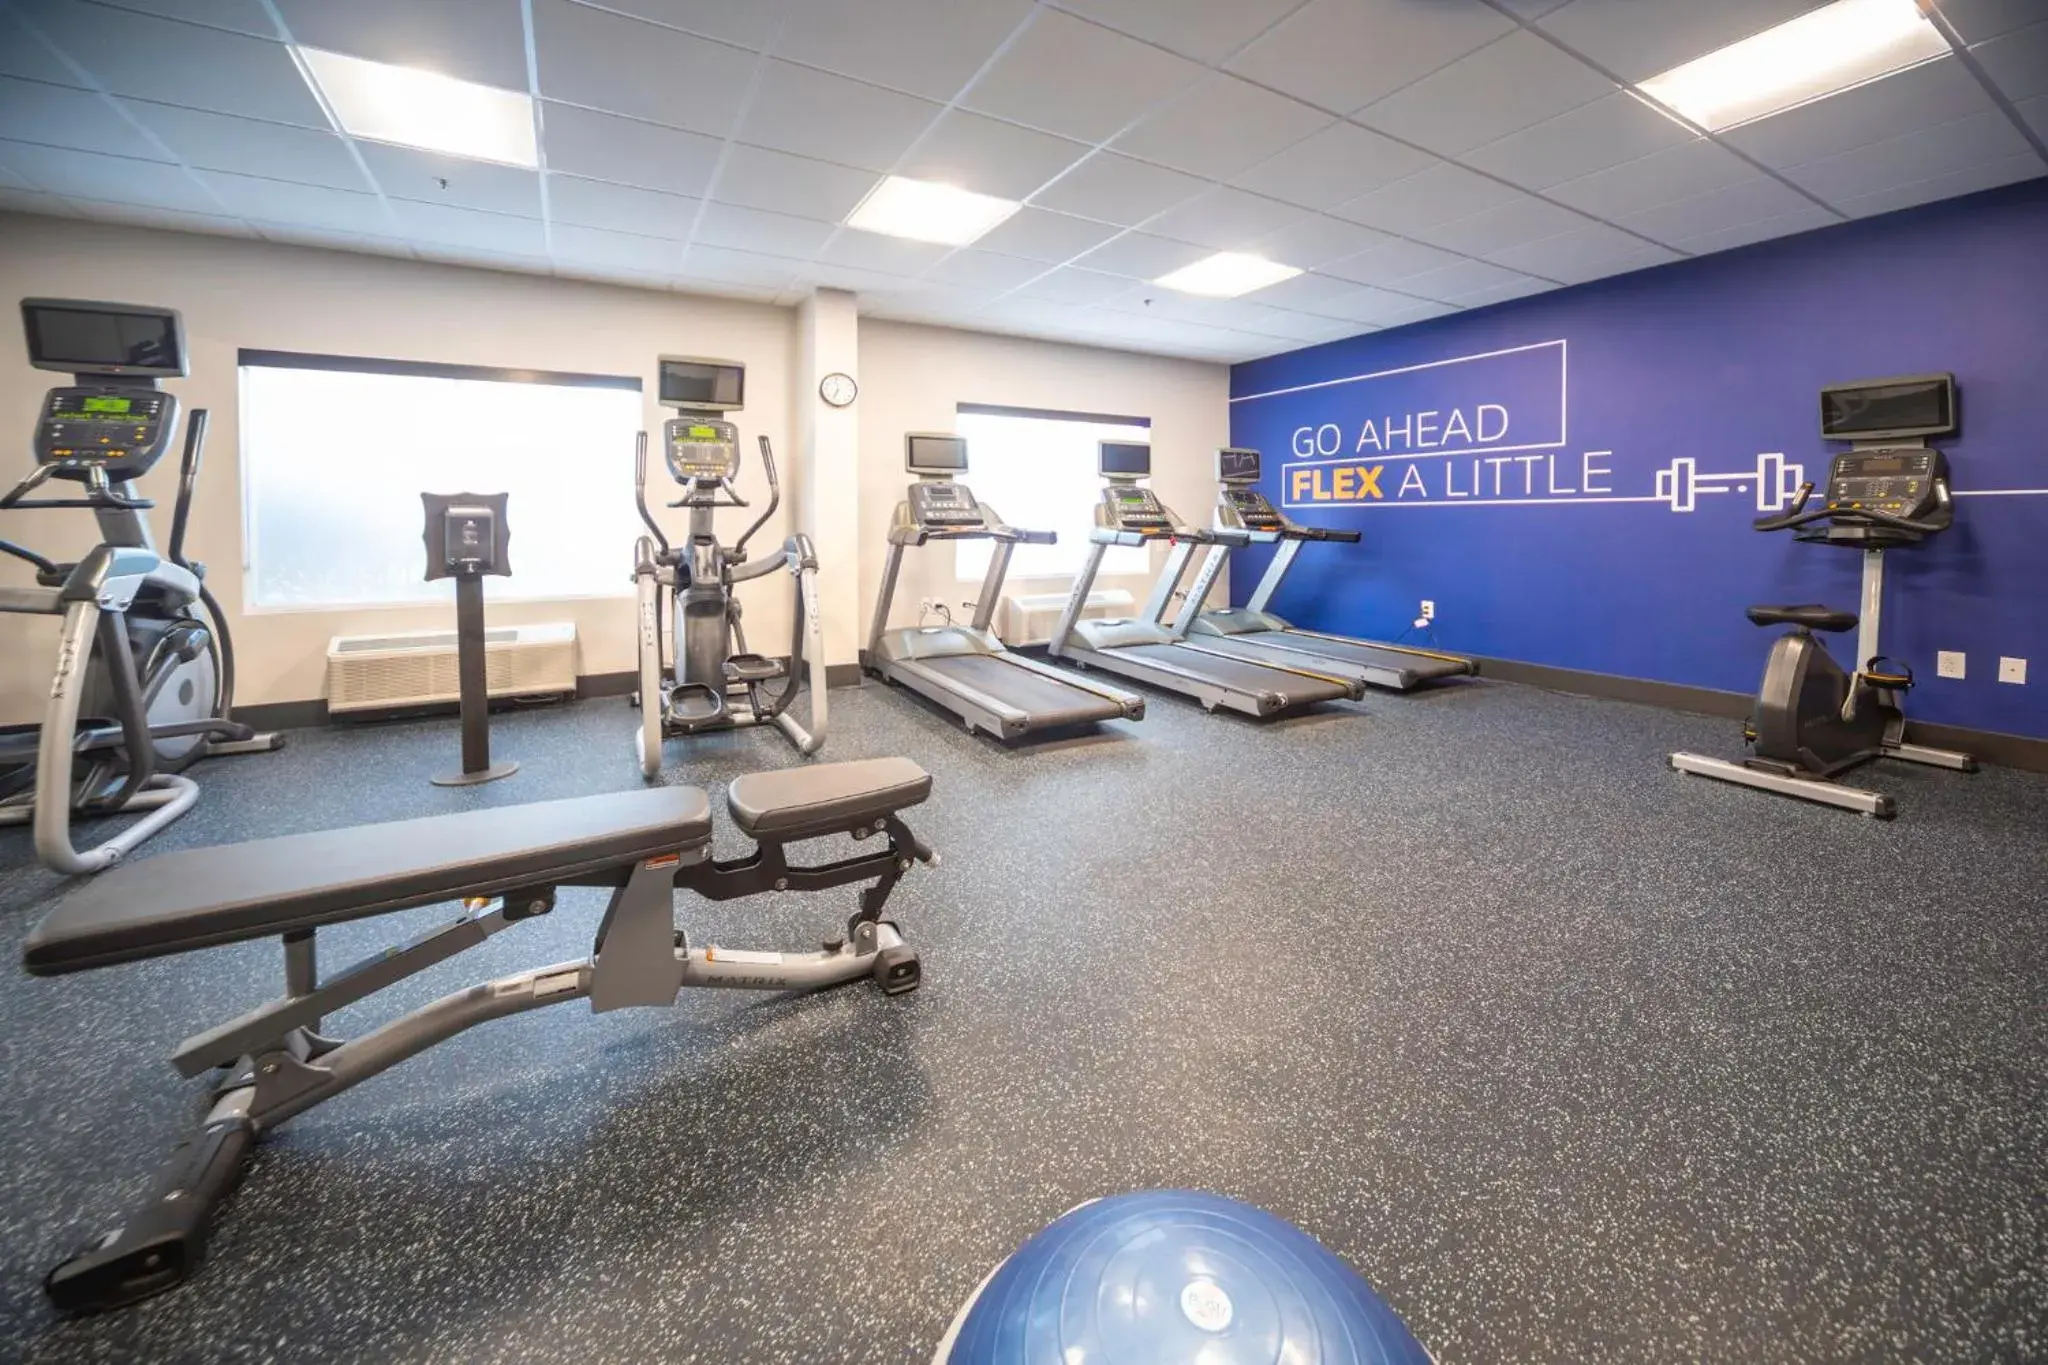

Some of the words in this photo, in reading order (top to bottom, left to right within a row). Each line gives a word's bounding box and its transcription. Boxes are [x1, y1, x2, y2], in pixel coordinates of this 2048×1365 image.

[1292, 424, 1342, 458] GO
[1356, 404, 1509, 453] AHEAD
[1292, 465, 1384, 501] FLEX
[1398, 463, 1428, 498] A
[1446, 450, 1613, 497] LITTLE
